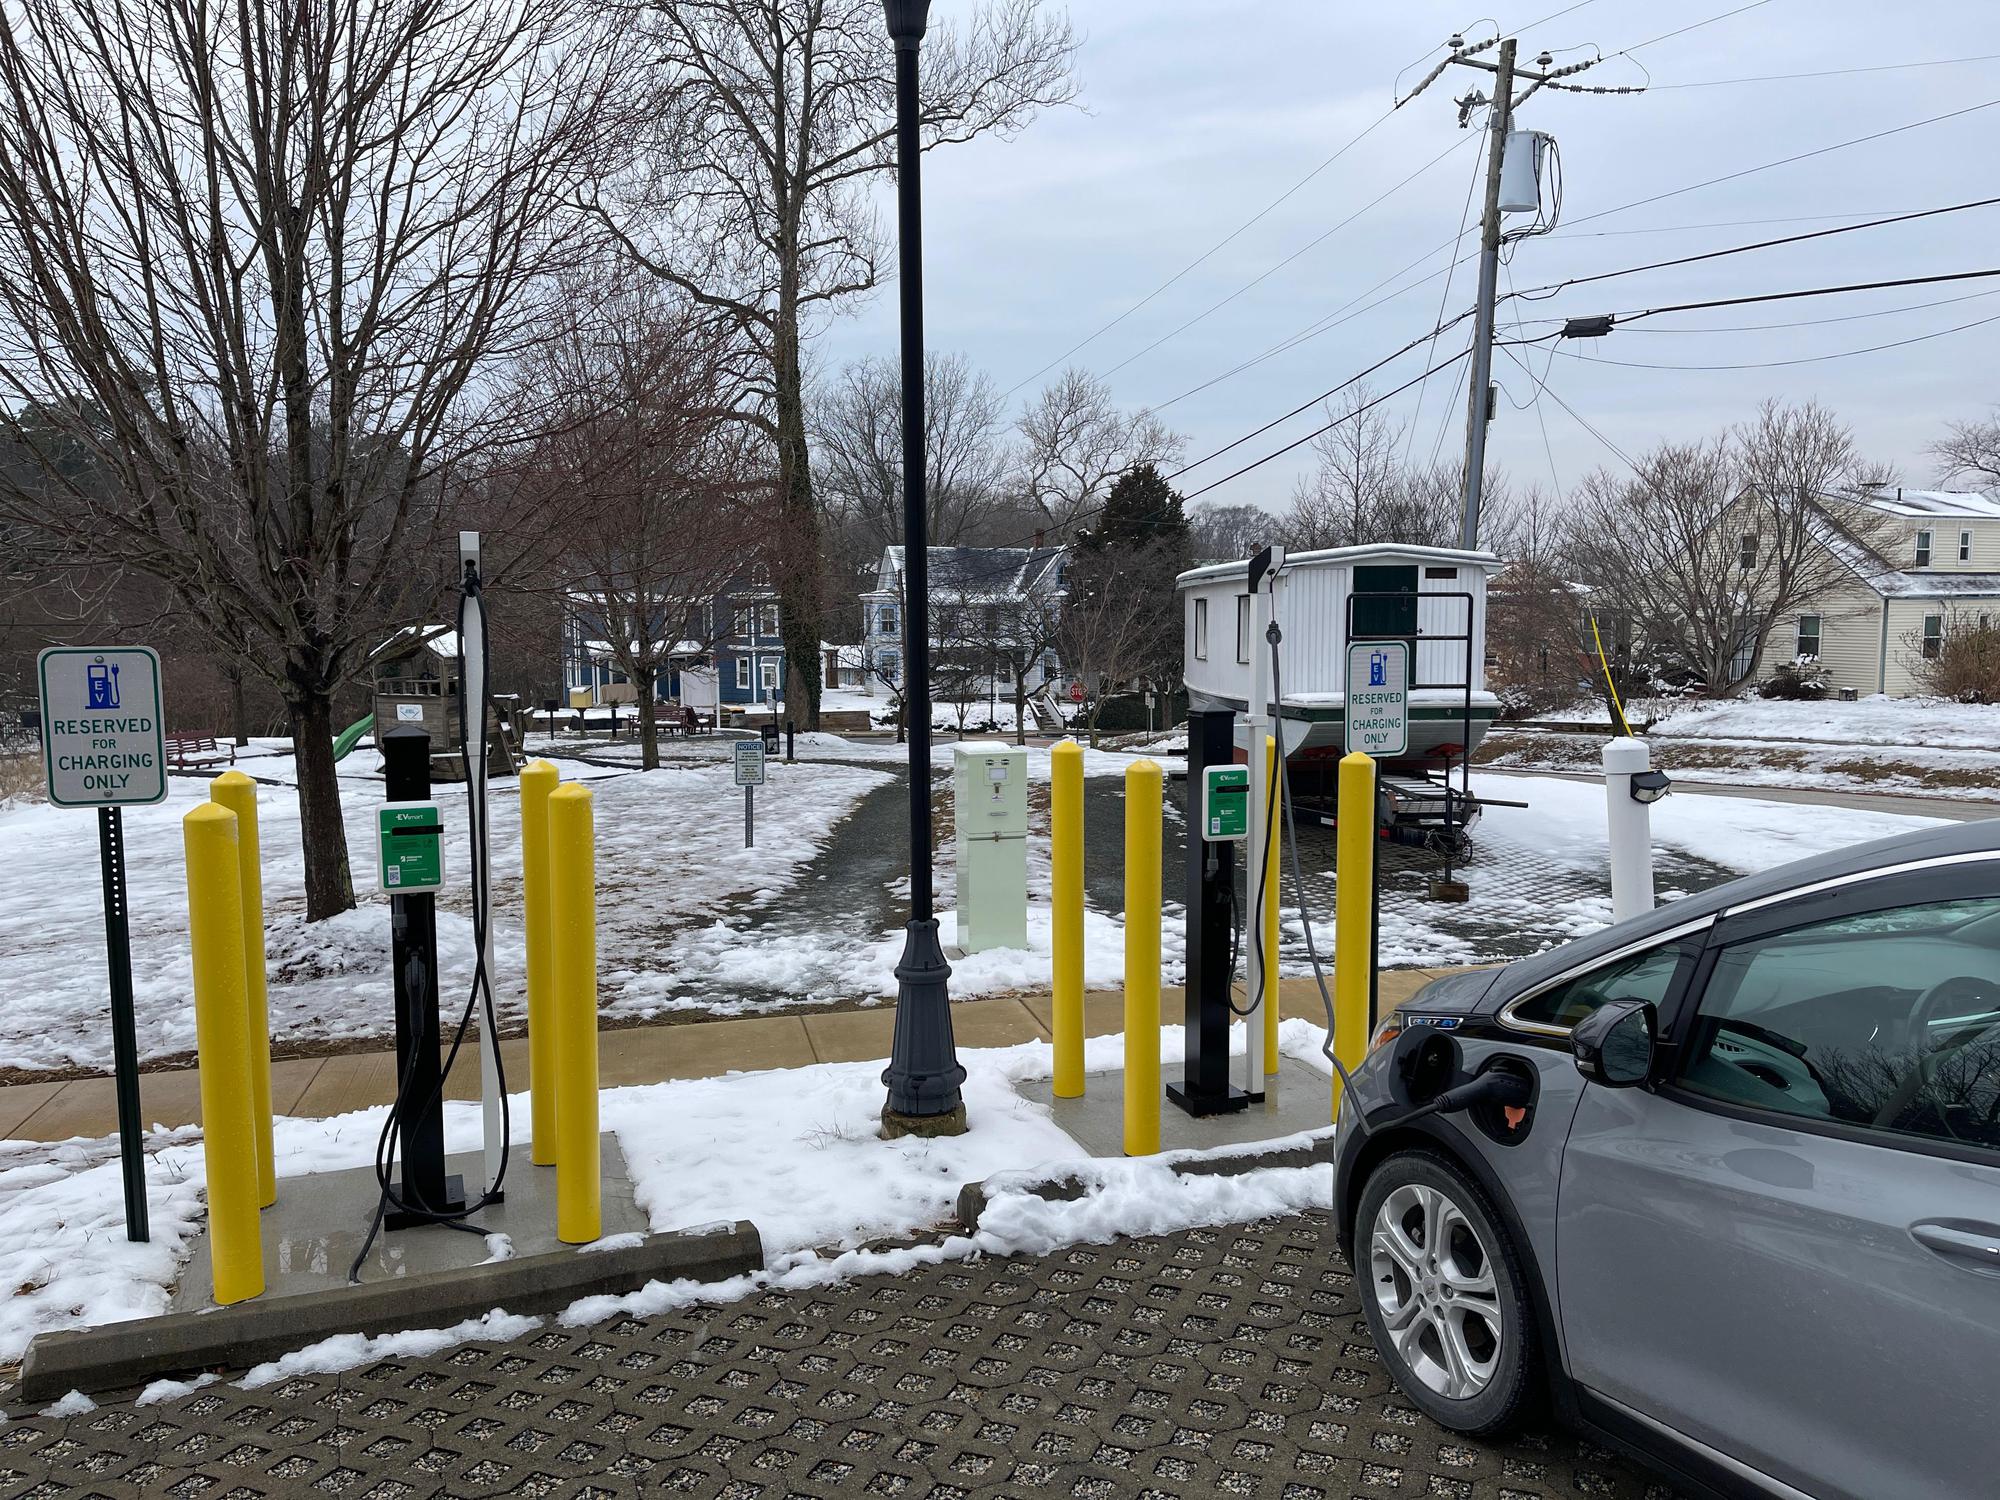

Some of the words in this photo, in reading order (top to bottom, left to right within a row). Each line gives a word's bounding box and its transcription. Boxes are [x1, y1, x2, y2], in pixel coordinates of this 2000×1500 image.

[94, 680, 104, 703] EV
[1352, 692, 1402, 704] RESERVED
[1370, 707, 1383, 715] FOR
[54, 718, 152, 735] RESERVED
[1352, 718, 1401, 731] CHARGING
[92, 739, 117, 749] FOR
[1364, 732, 1389, 744] ONLY
[58, 753, 153, 771] CHARGING
[83, 774, 130, 790] ONLY
